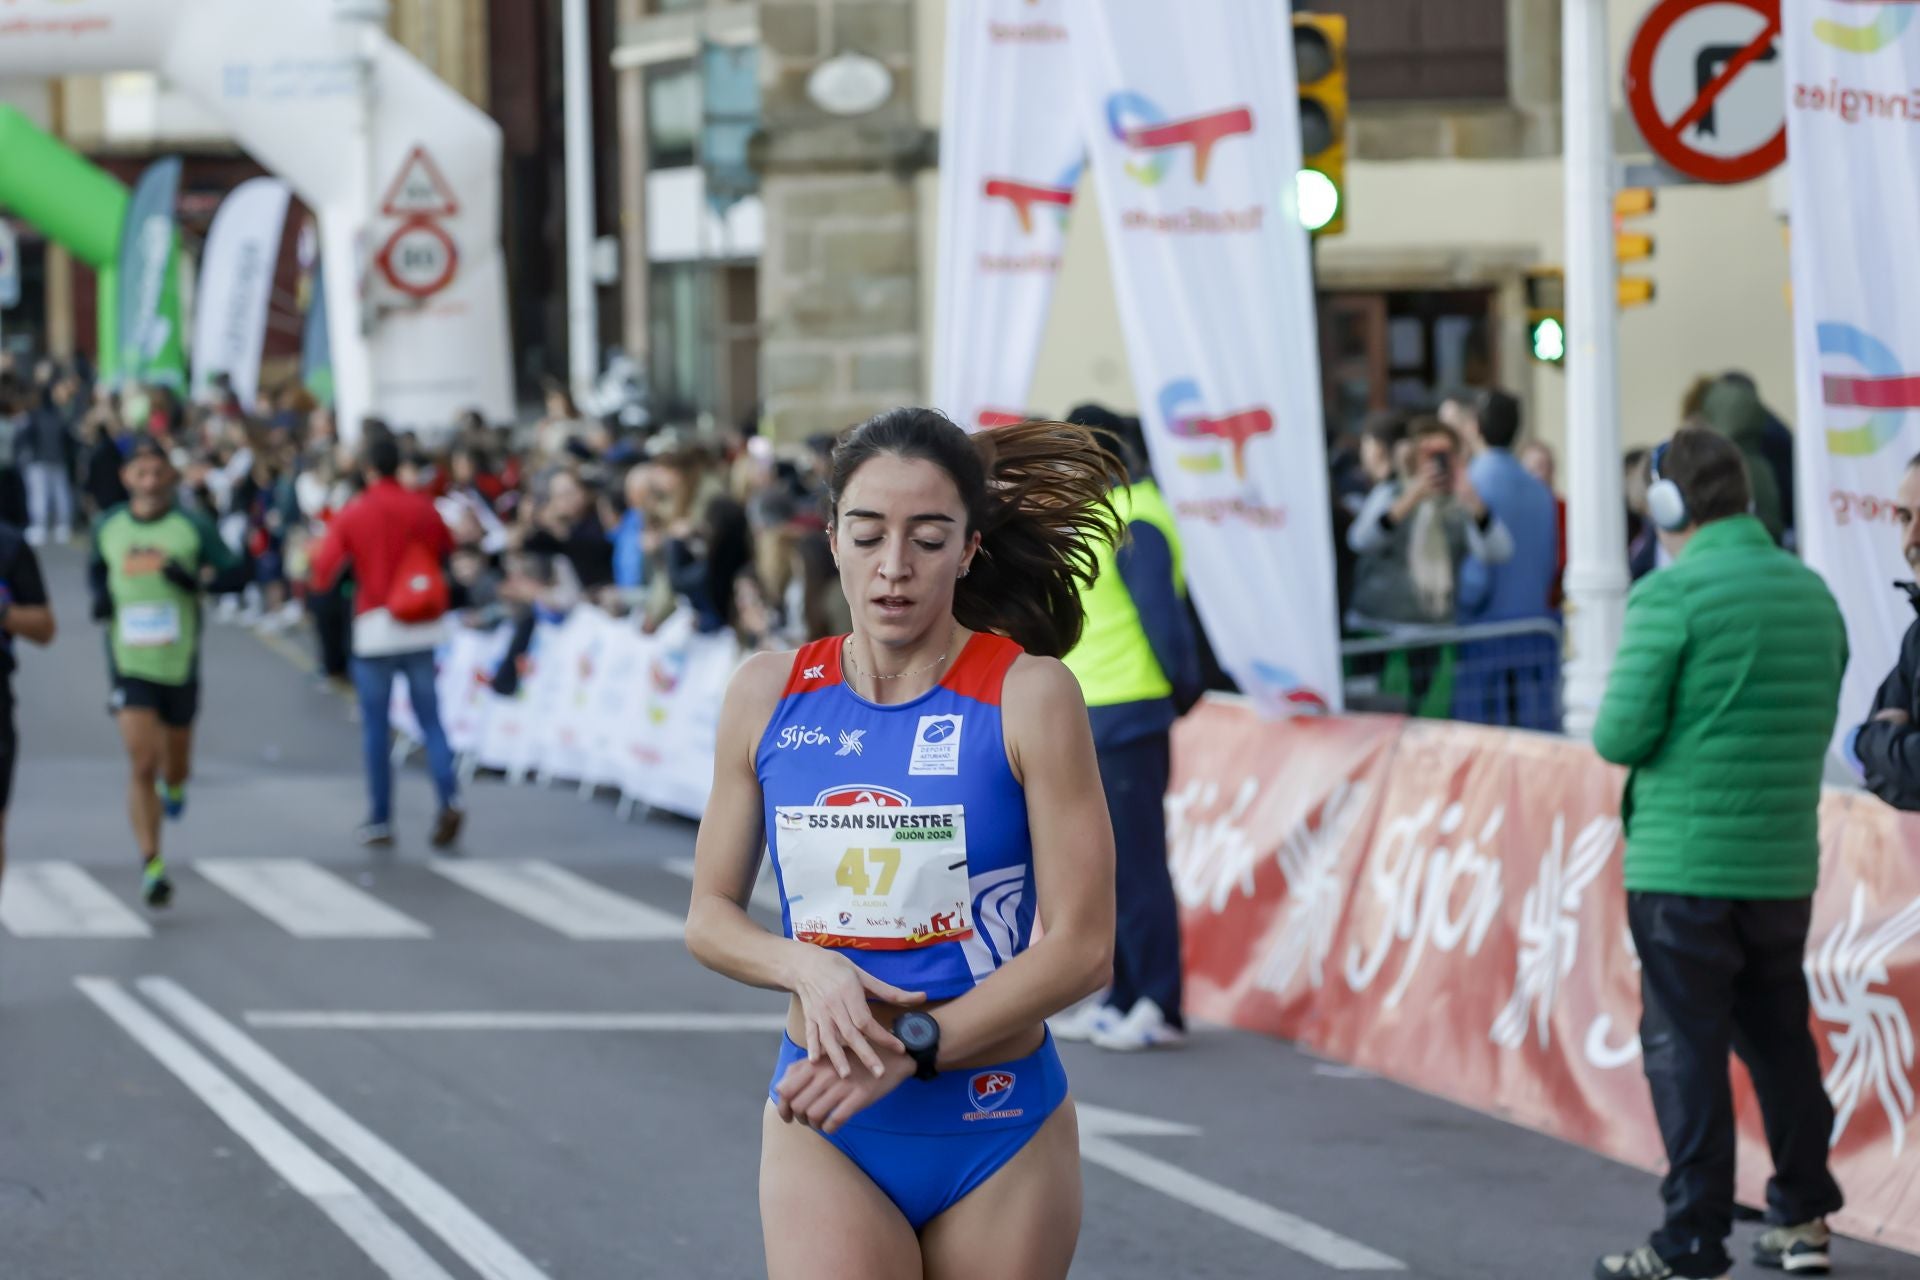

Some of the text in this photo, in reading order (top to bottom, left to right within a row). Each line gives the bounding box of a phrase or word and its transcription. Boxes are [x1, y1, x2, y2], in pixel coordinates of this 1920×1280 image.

[776, 724, 831, 751] gijón
[809, 814, 953, 829] 55 SAN SILVESTRE
[927, 830, 952, 840] 2024
[836, 847, 901, 896] 47
